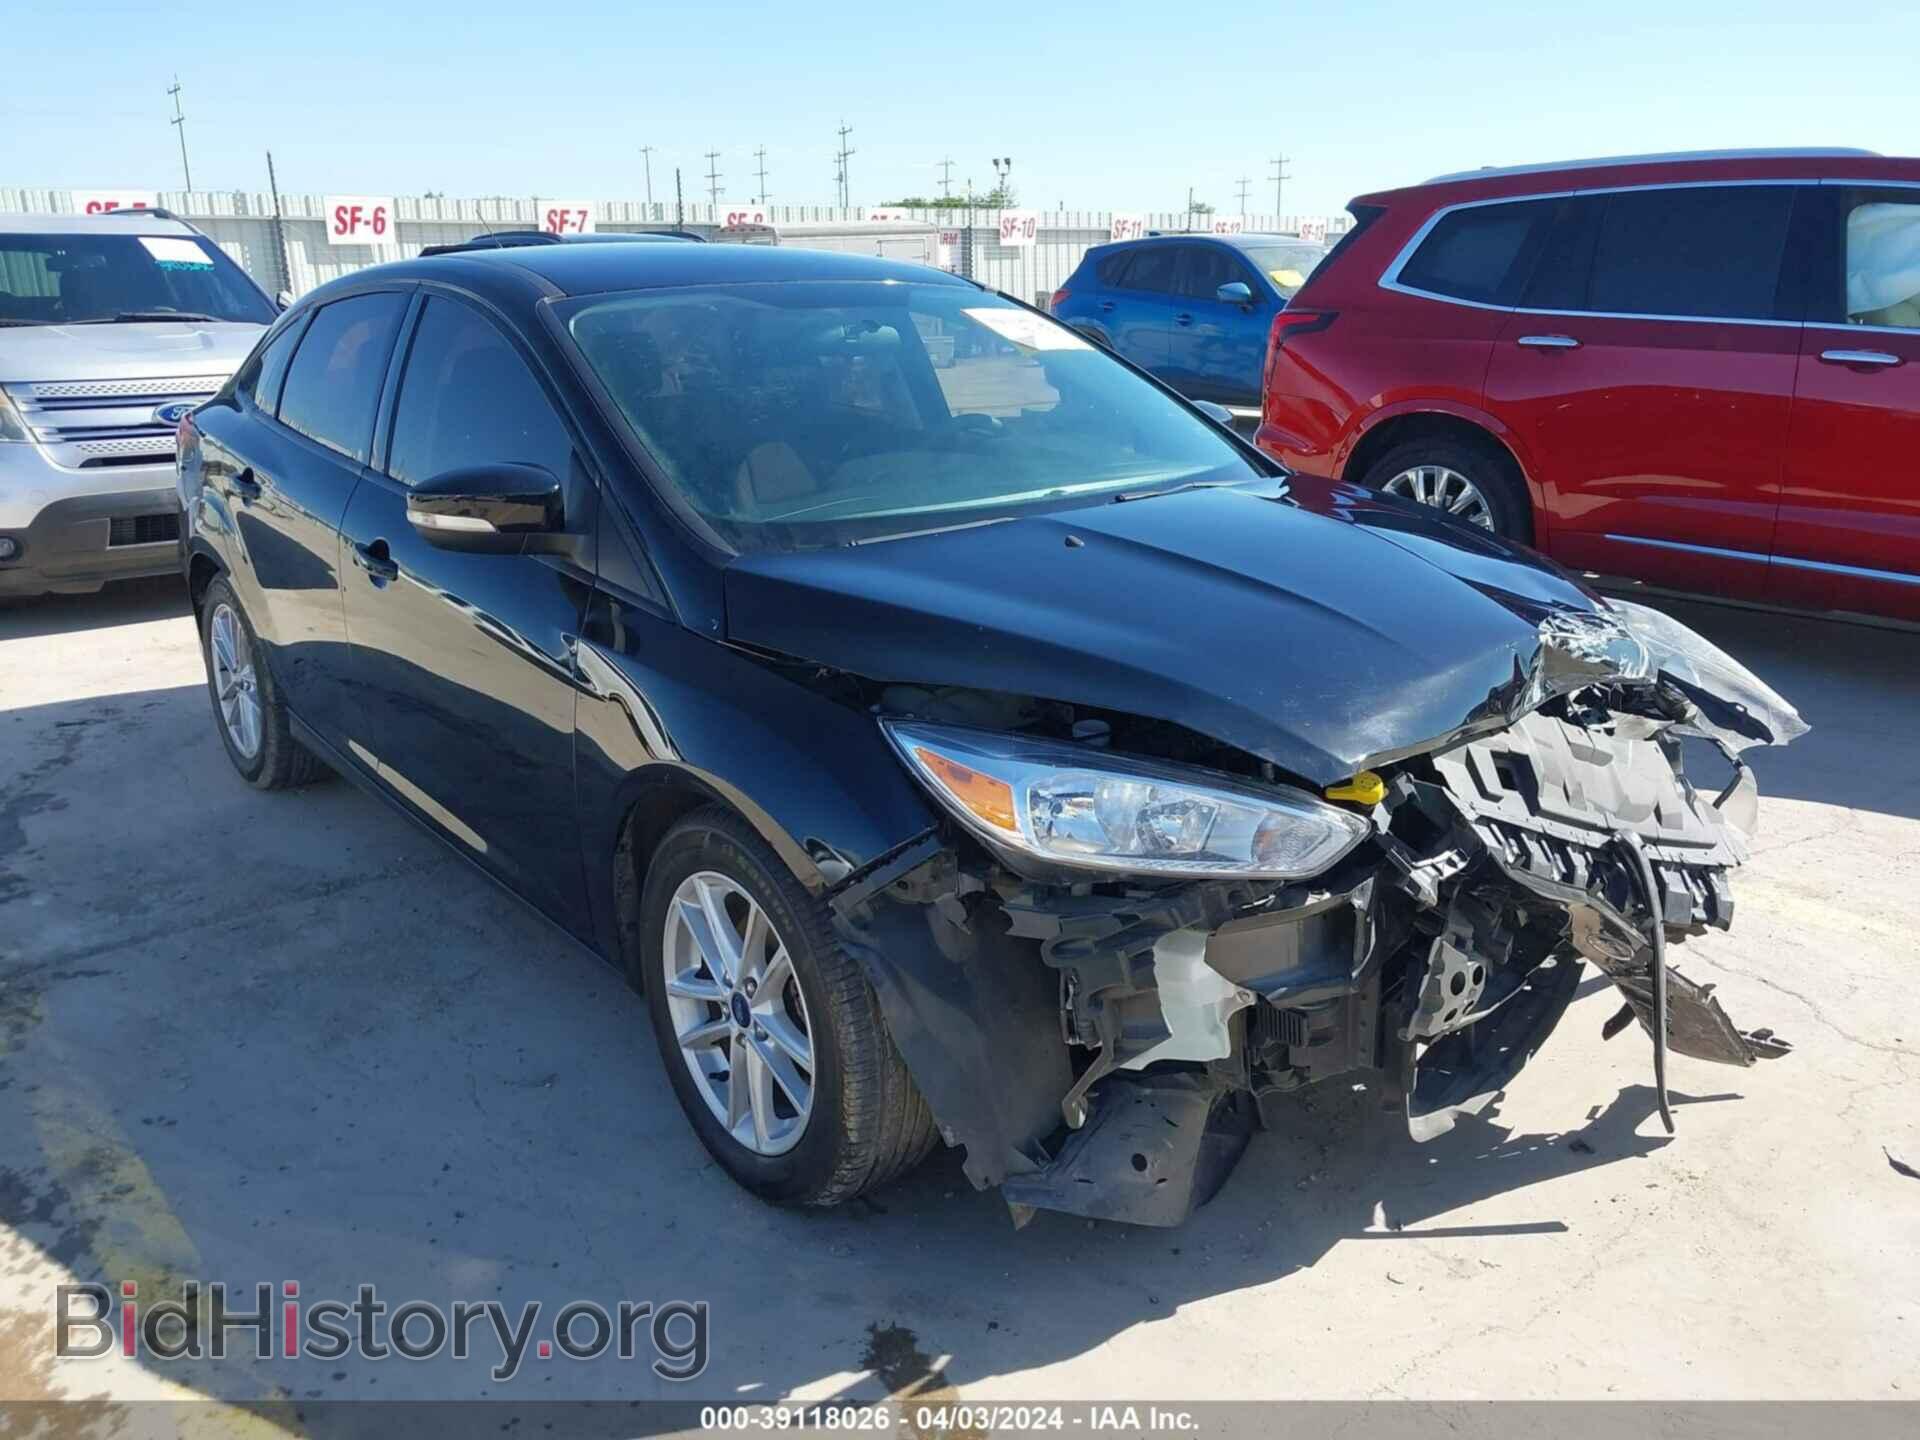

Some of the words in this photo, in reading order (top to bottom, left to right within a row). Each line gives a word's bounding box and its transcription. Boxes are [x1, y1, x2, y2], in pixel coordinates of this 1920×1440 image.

[334, 206, 387, 236] SF-6
[545, 208, 588, 234] SF-7
[1001, 216, 1036, 239] SF-10
[1112, 219, 1142, 240] SF-11
